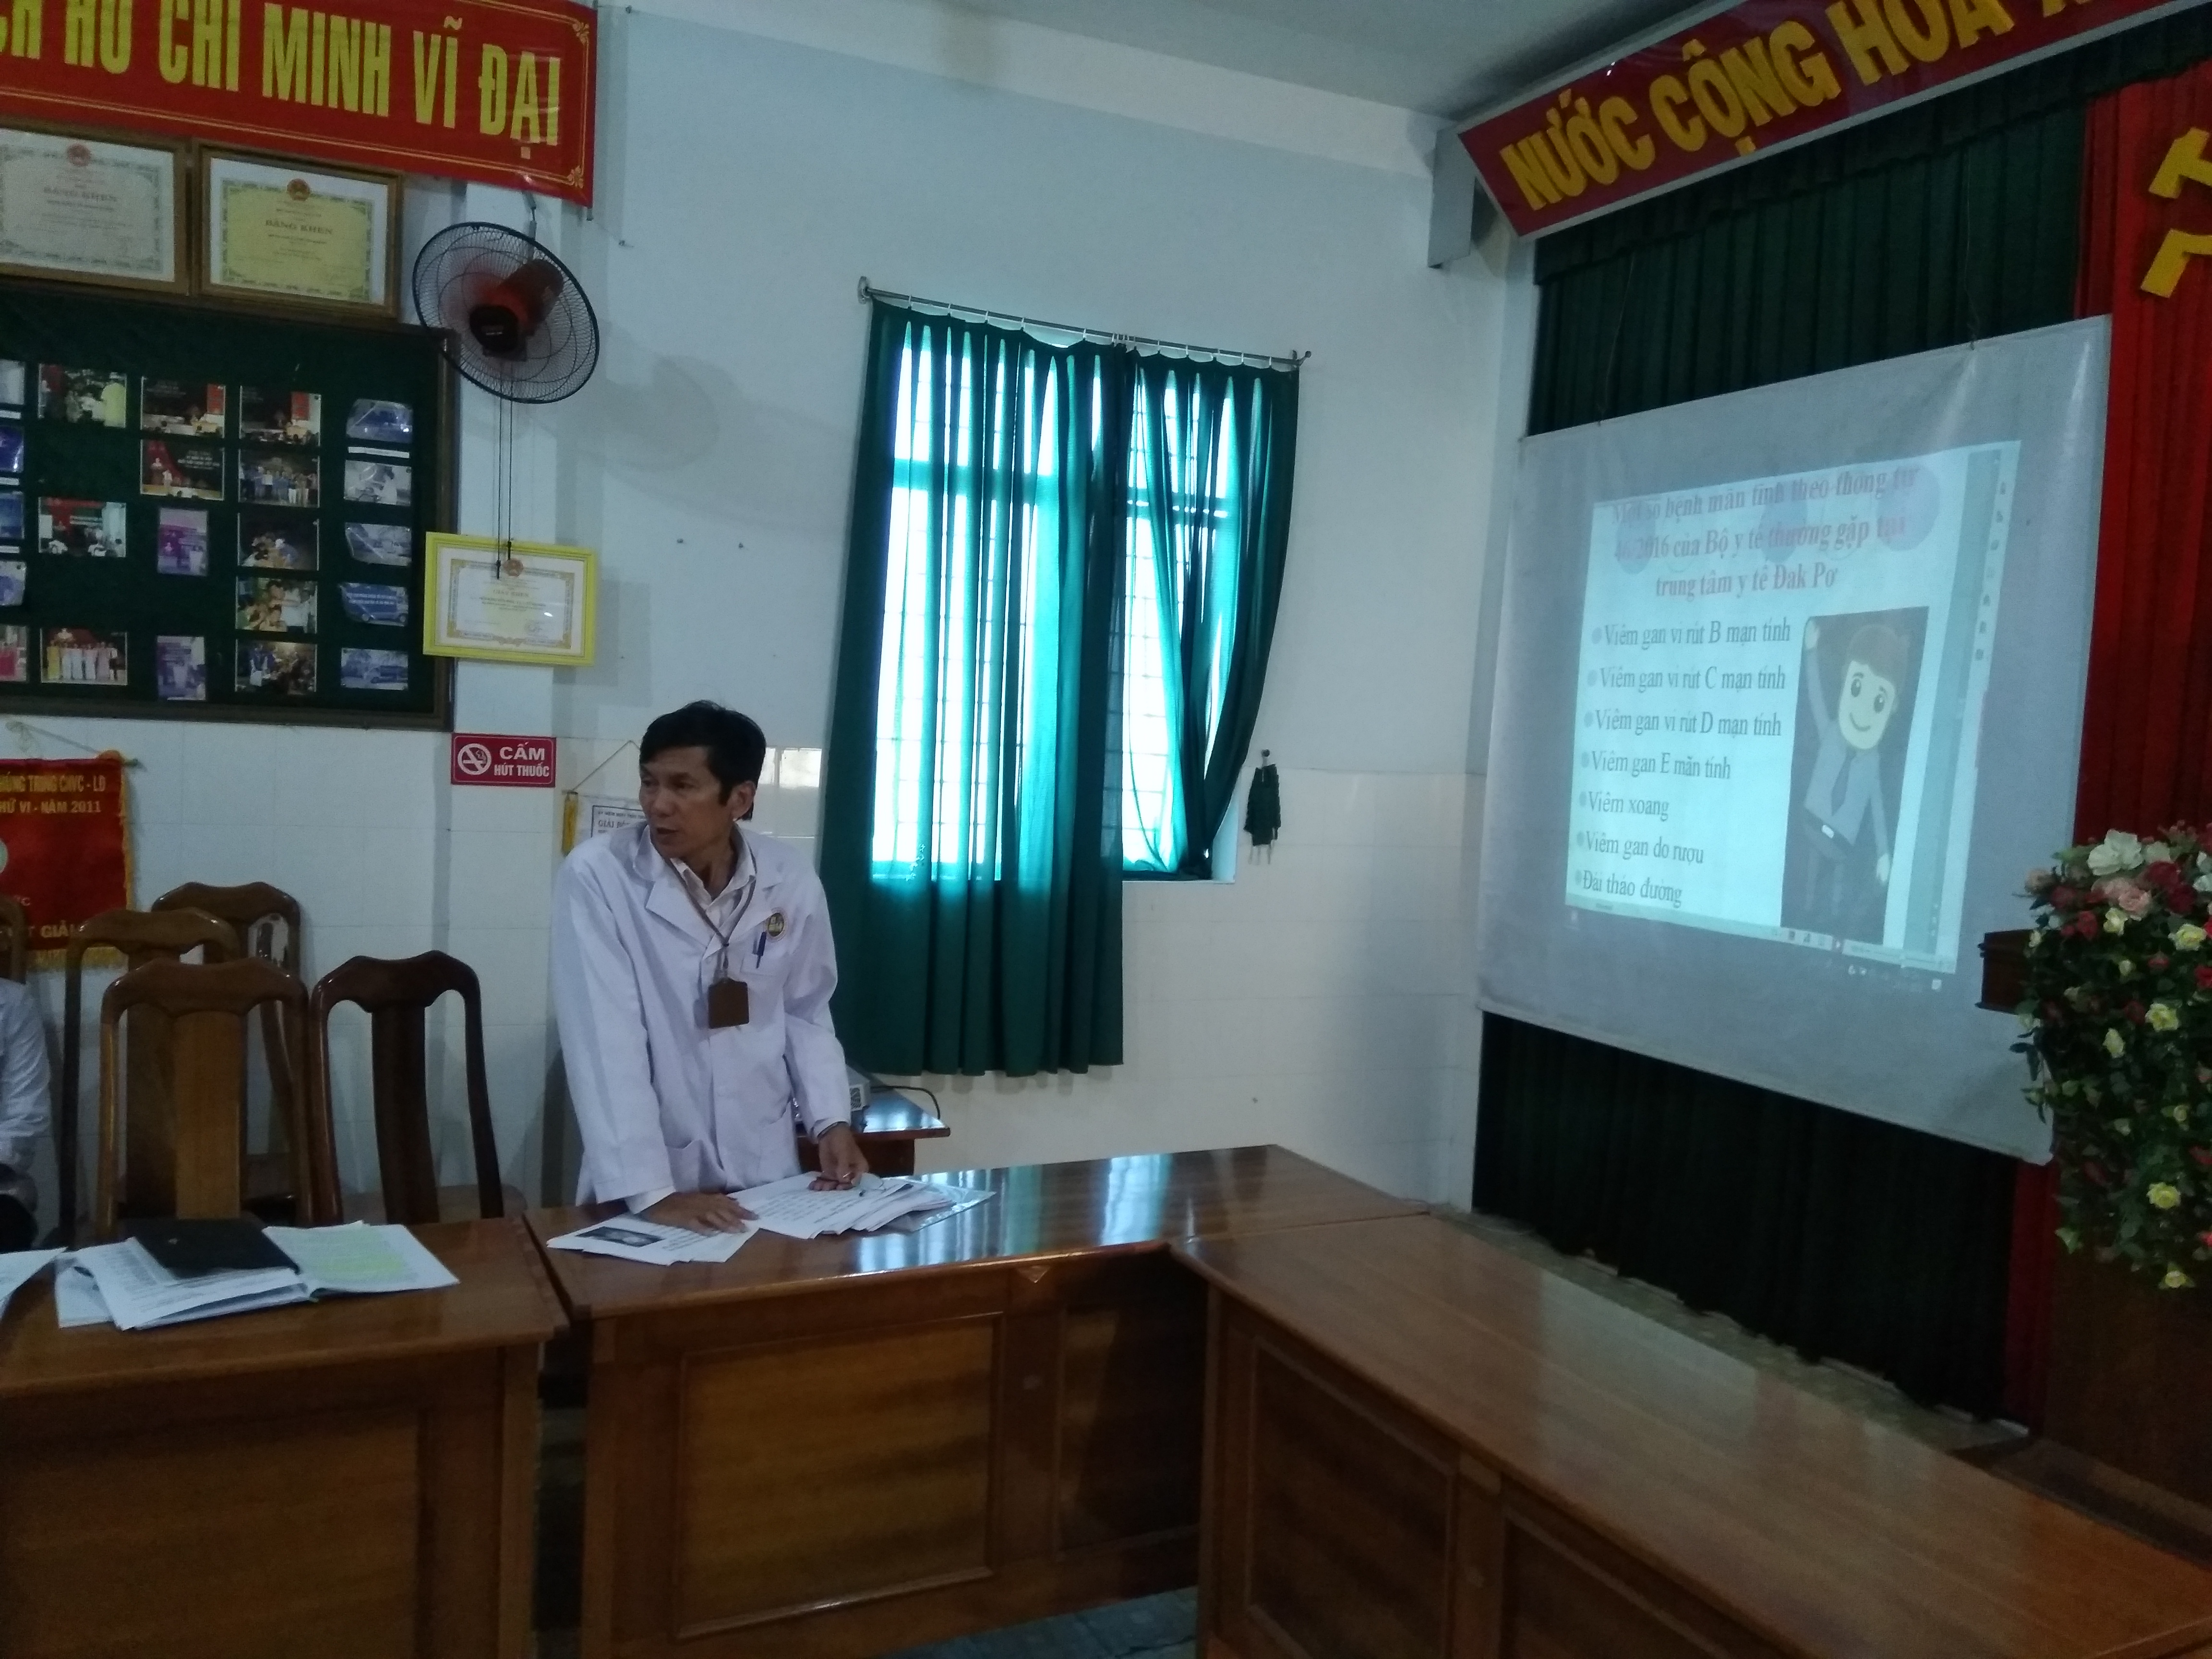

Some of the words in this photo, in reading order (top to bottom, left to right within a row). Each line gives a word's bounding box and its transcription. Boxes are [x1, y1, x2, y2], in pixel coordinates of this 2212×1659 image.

[262, 2, 391, 117] MINH
[413, 15, 463, 129] VĨ
[478, 43, 560, 159] ĐẠI
[1500, 88, 1655, 211] NƯỚC
[1649, 21, 1842, 156] CỘNG
[1705, 527, 1729, 559] Bộ
[1731, 533, 1744, 559] y
[1656, 577, 1696, 602] trung
[1700, 569, 1732, 596] tâm
[1737, 575, 1747, 599] y
[1641, 627, 1666, 650] gan
[1708, 620, 1721, 644] B
[1763, 616, 1791, 642] tính
[1638, 672, 1663, 694] gan
[1705, 665, 1718, 689] C
[1758, 664, 1786, 690] tính
[1635, 715, 1659, 736] gan
[1699, 711, 1713, 734] D
[1754, 712, 1782, 736] tính
[499, 742, 545, 761] CẤM
[493, 762, 514, 776] HÚT
[517, 761, 550, 777] THUỐC
[1631, 757, 1656, 778] gan
[1659, 752, 1671, 774] E
[1704, 756, 1731, 780] tính
[71, 800, 102, 813] 2011
[1628, 798, 1670, 822] xoang
[1623, 840, 1649, 860] gan
[1653, 836, 1670, 859] do
